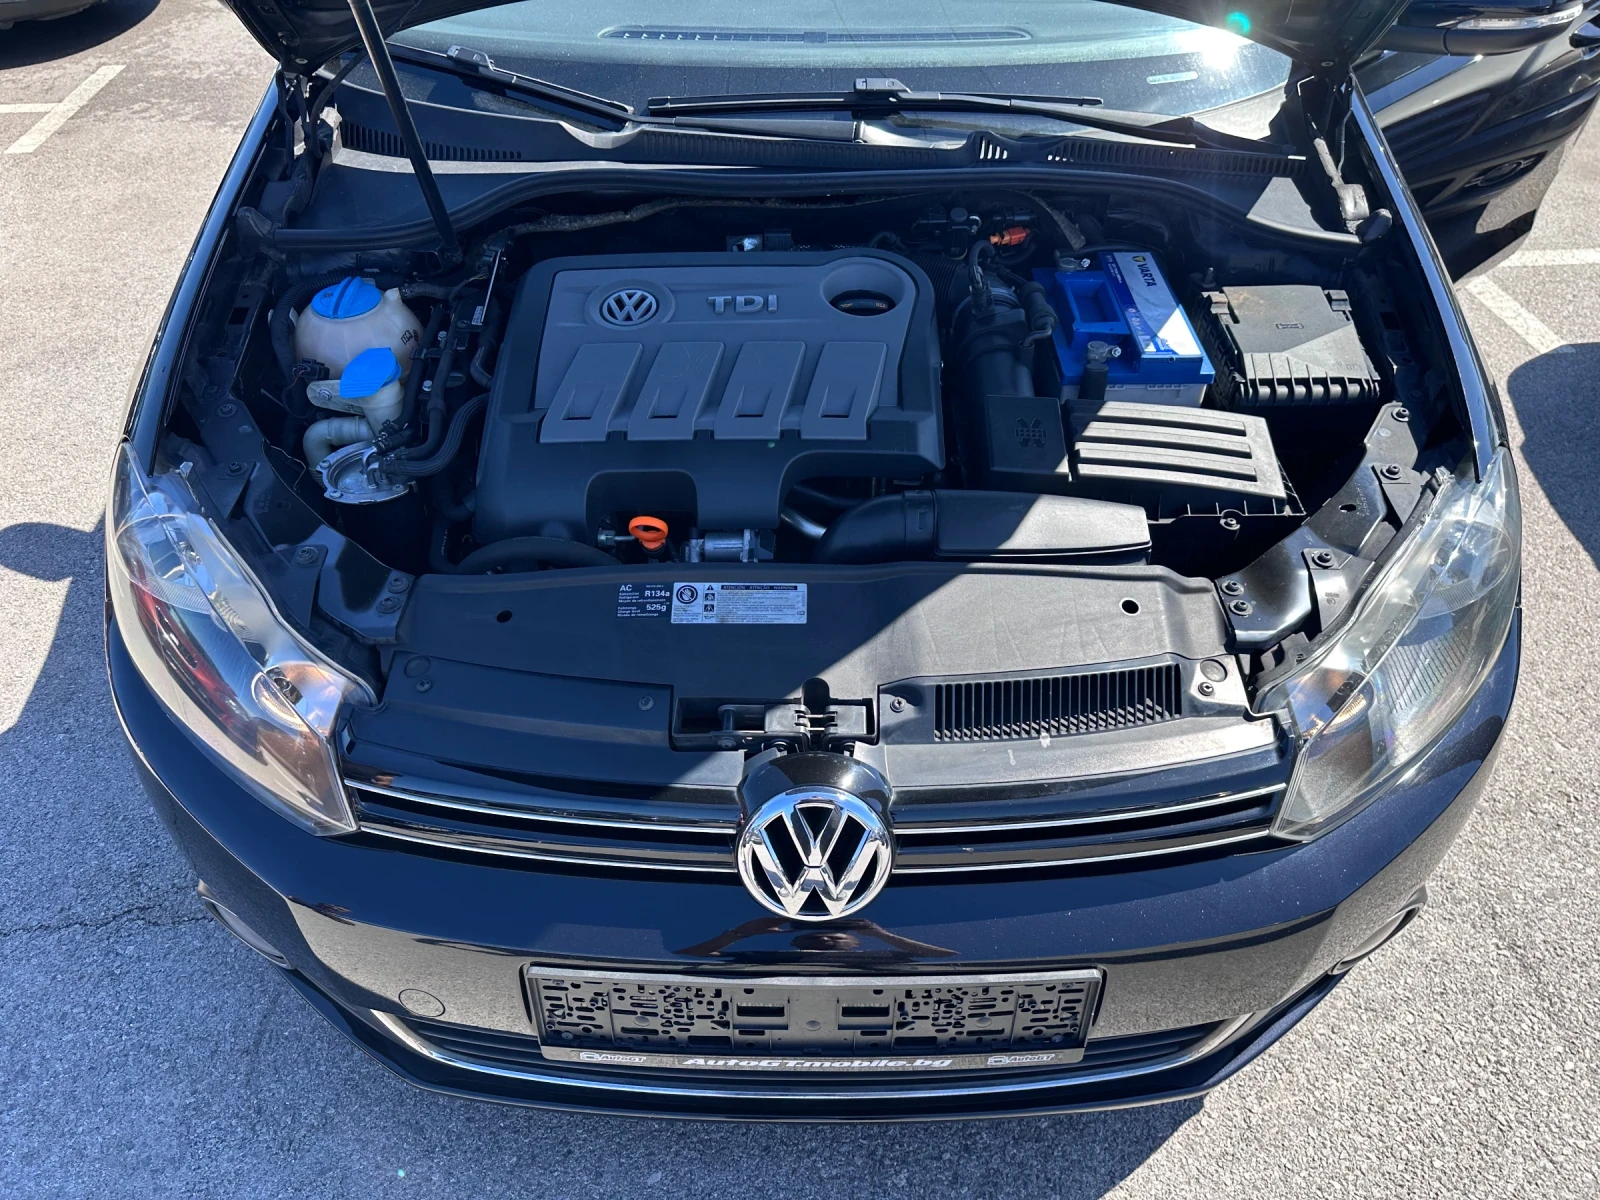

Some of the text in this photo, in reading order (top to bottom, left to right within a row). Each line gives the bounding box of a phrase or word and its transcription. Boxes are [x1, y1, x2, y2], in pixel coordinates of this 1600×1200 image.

[1137, 263, 1157, 287] VARTA
[707, 294, 778, 314] TDI
[600, 1054, 646, 1063] AutoGT
[1008, 1054, 1055, 1062] AutoGT
